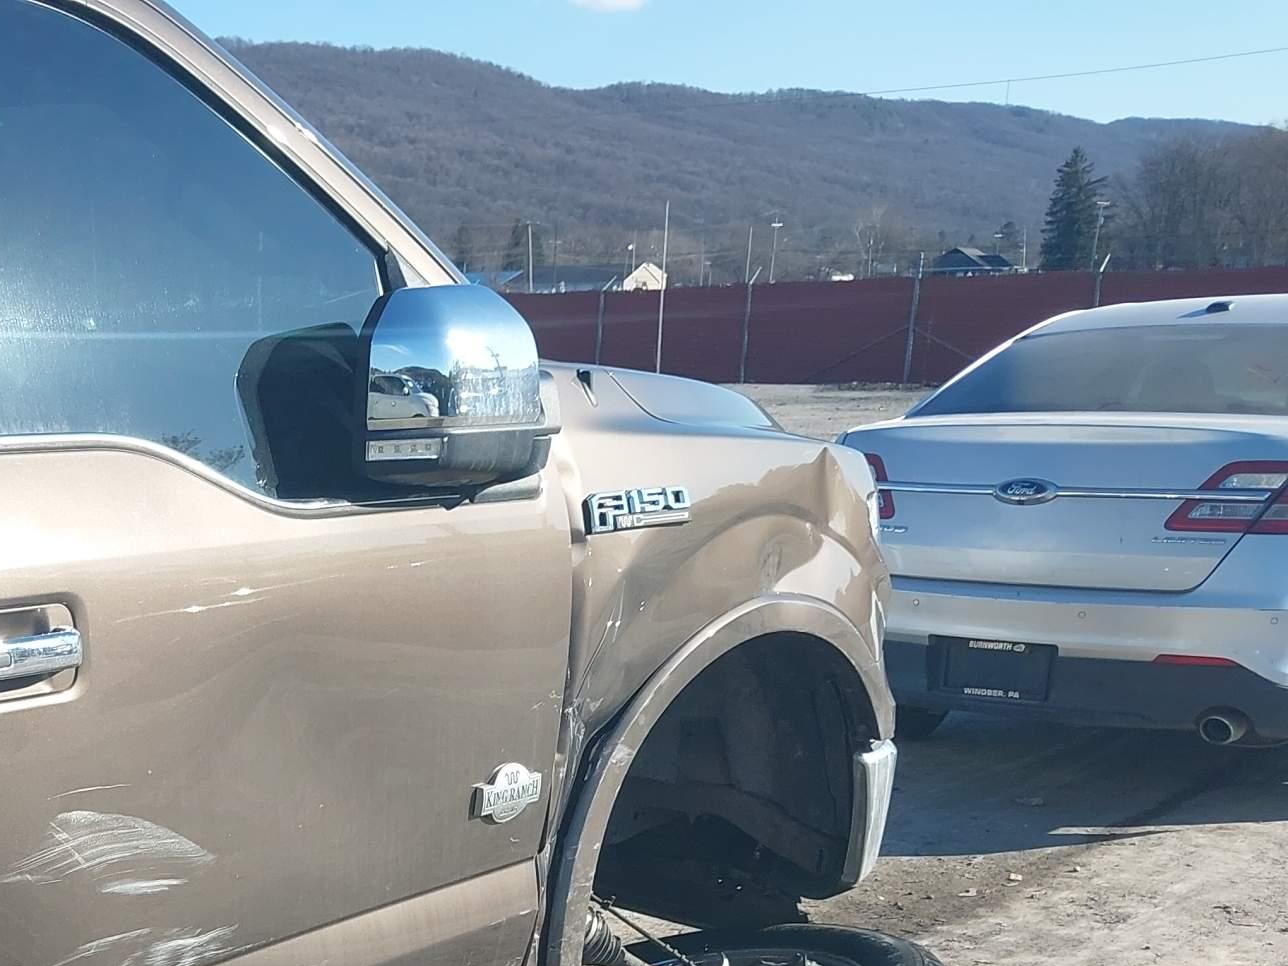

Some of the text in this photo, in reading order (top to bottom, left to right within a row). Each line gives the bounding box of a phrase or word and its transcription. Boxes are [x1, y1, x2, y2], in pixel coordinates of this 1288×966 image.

[1007, 482, 1037, 495] Ford
[1007, 690, 1020, 699] PA
[486, 779, 539, 809] KING RANCH
